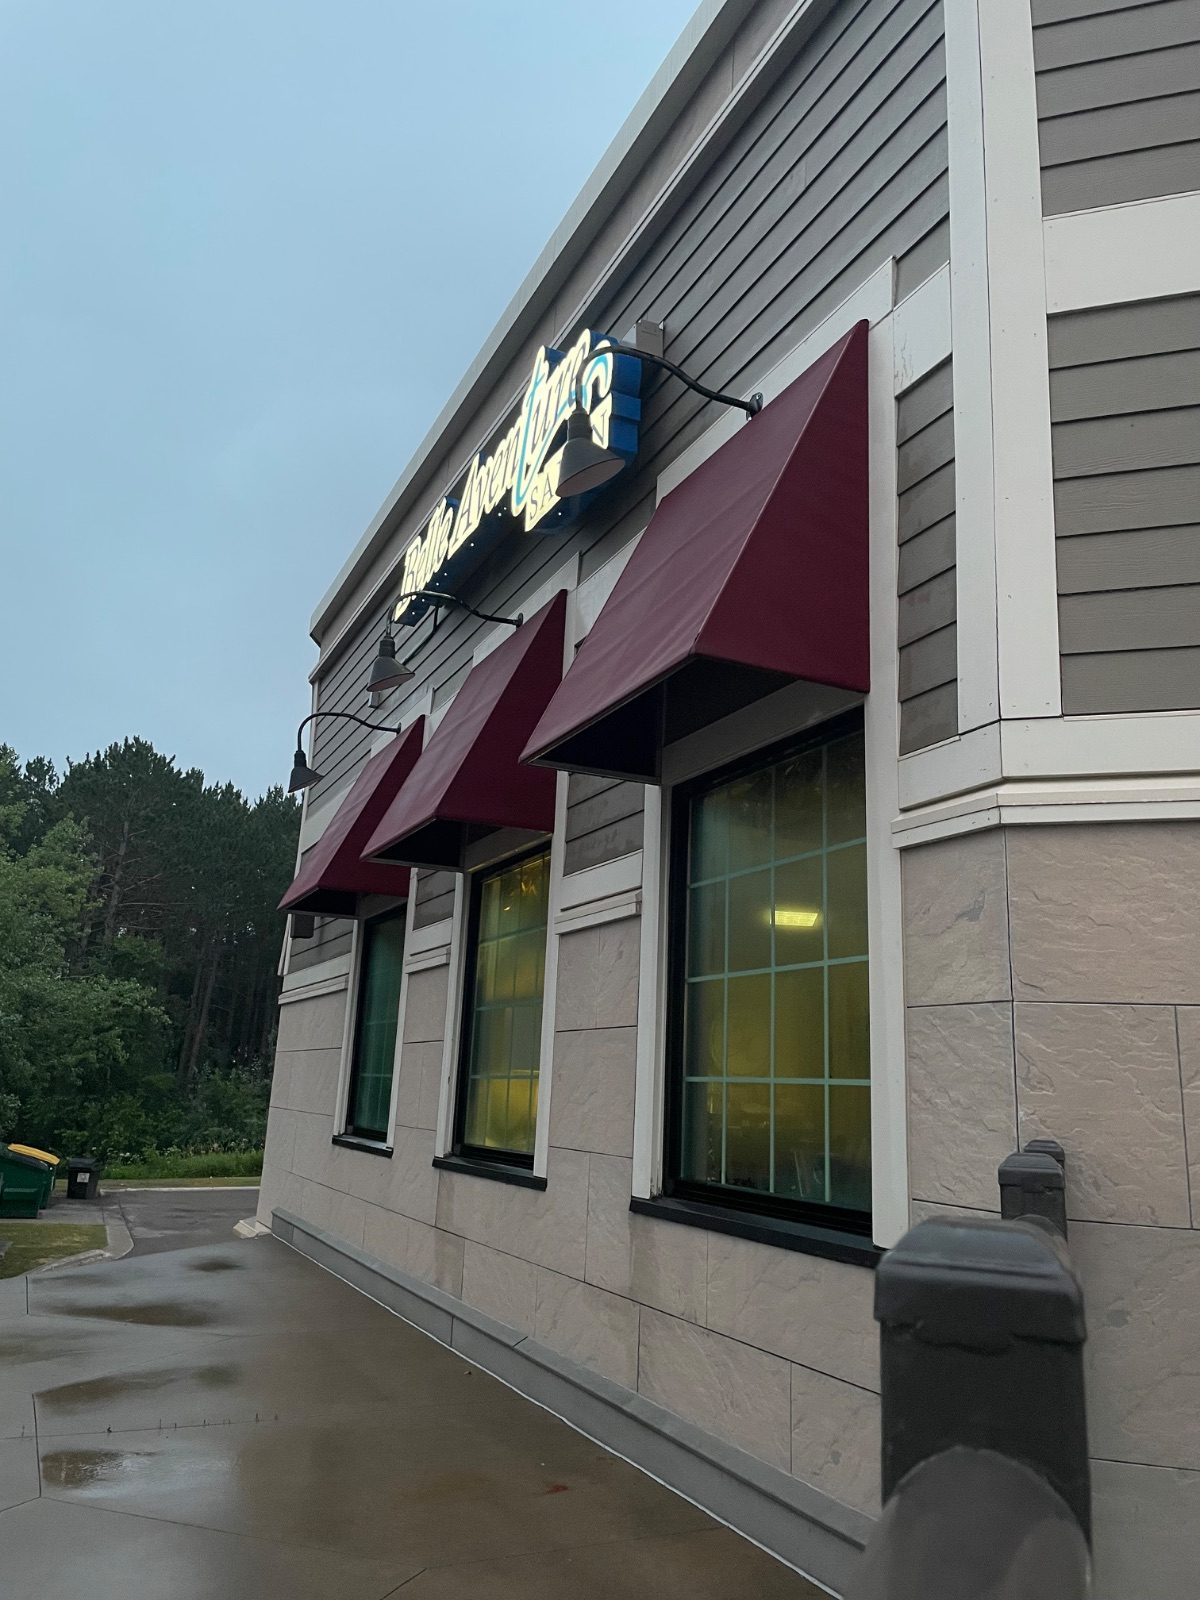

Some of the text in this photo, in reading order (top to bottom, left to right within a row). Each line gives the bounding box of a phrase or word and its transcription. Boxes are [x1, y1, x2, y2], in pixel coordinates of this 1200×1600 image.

[396, 334, 611, 616] Belle Aventure
[528, 406, 609, 522] SAN
